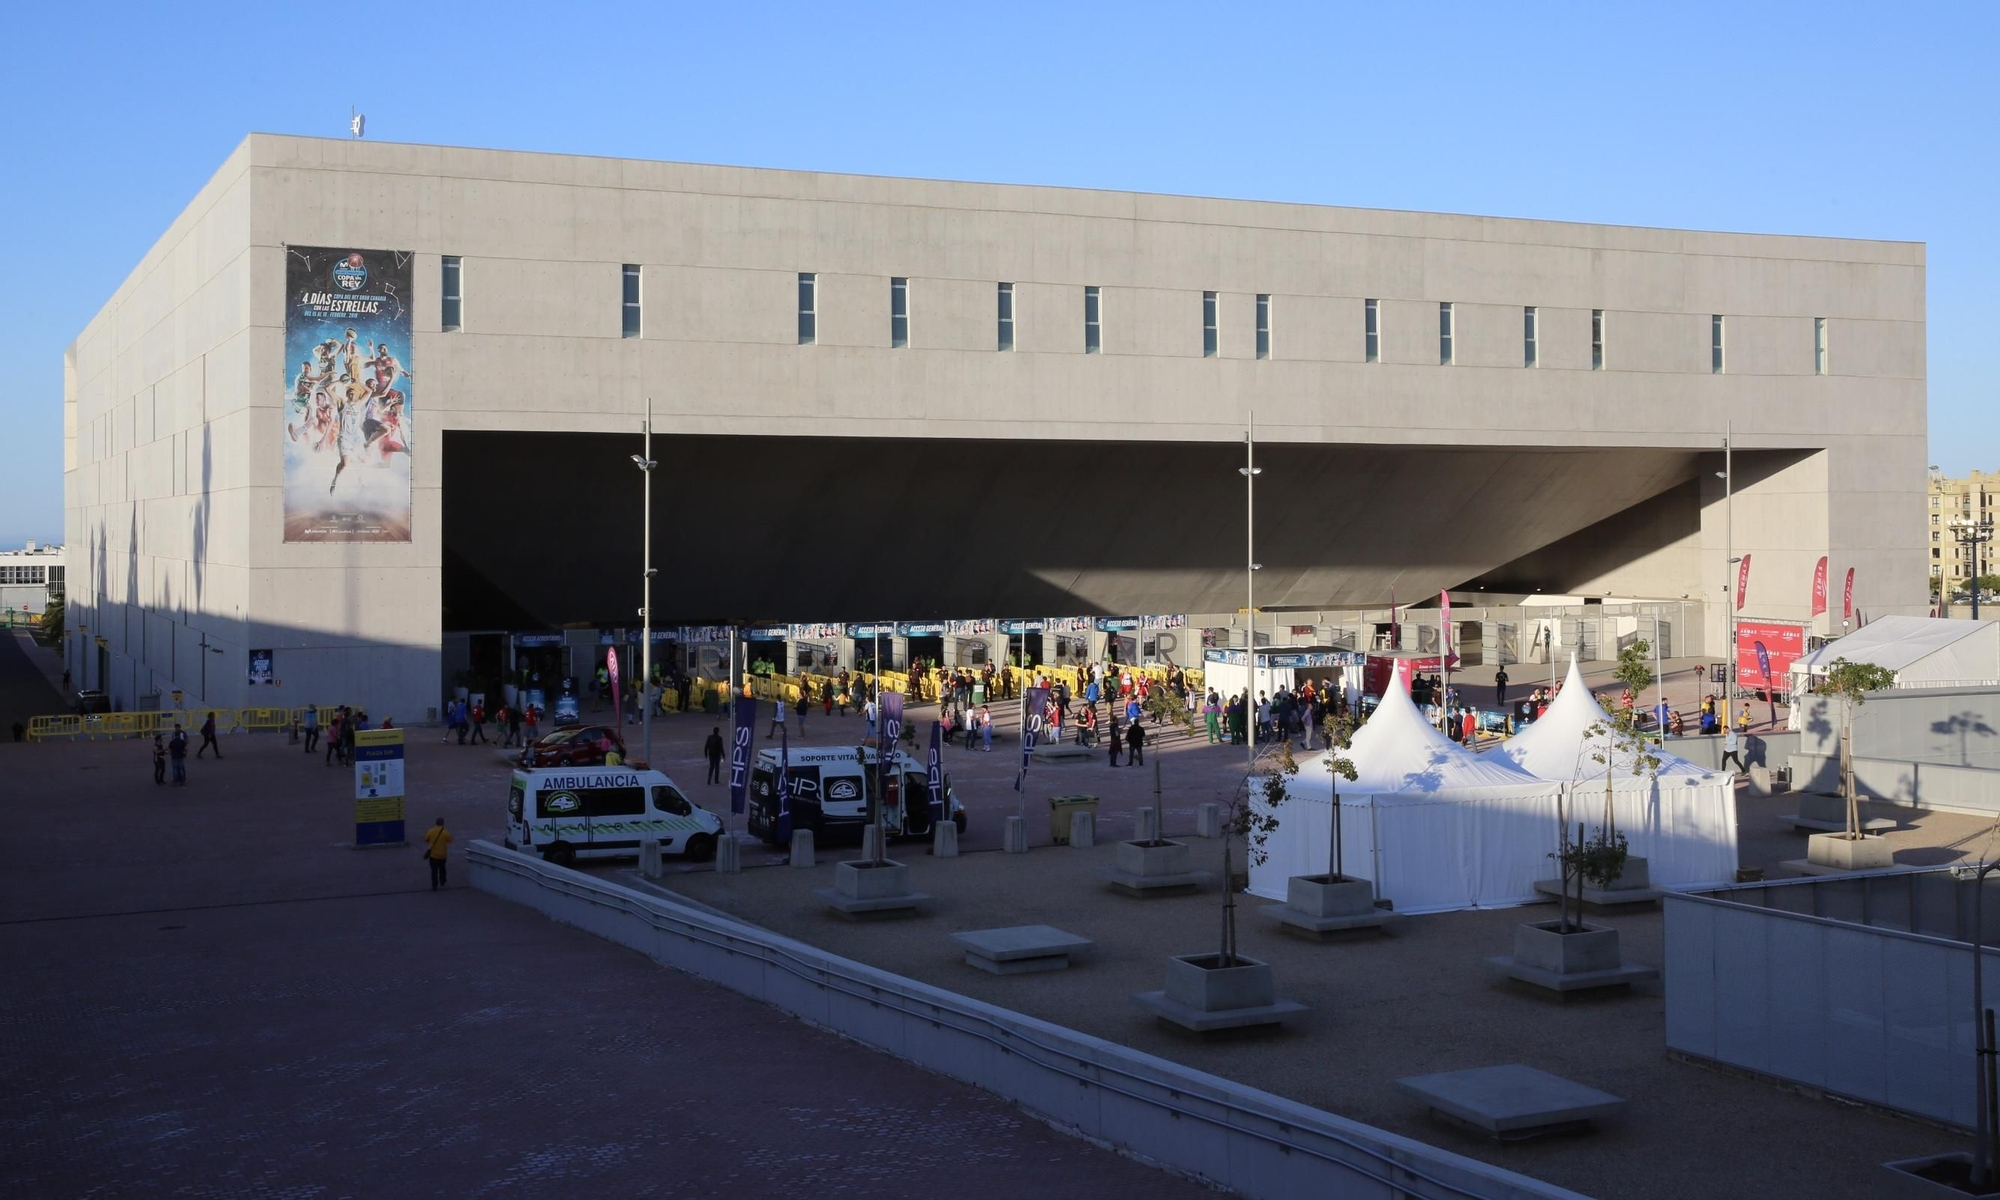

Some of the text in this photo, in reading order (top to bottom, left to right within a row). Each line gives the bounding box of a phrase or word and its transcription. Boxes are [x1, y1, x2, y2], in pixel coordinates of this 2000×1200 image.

[302, 290, 332, 305] 4 DÍAS
[331, 300, 378, 313] ESTRELLAS
[1025, 622, 1043, 630] GENERAL
[1121, 619, 1138, 627] GENERAL
[767, 628, 787, 636] GENERAL
[910, 624, 944, 633] ACCESO GENERAL
[657, 630, 677, 639] GENERAL
[731, 726, 750, 788] HPS
[801, 753, 836, 762] SOPORTE
[838, 753, 859, 761] VITAL
[543, 775, 639, 789] AMBULANCIA
